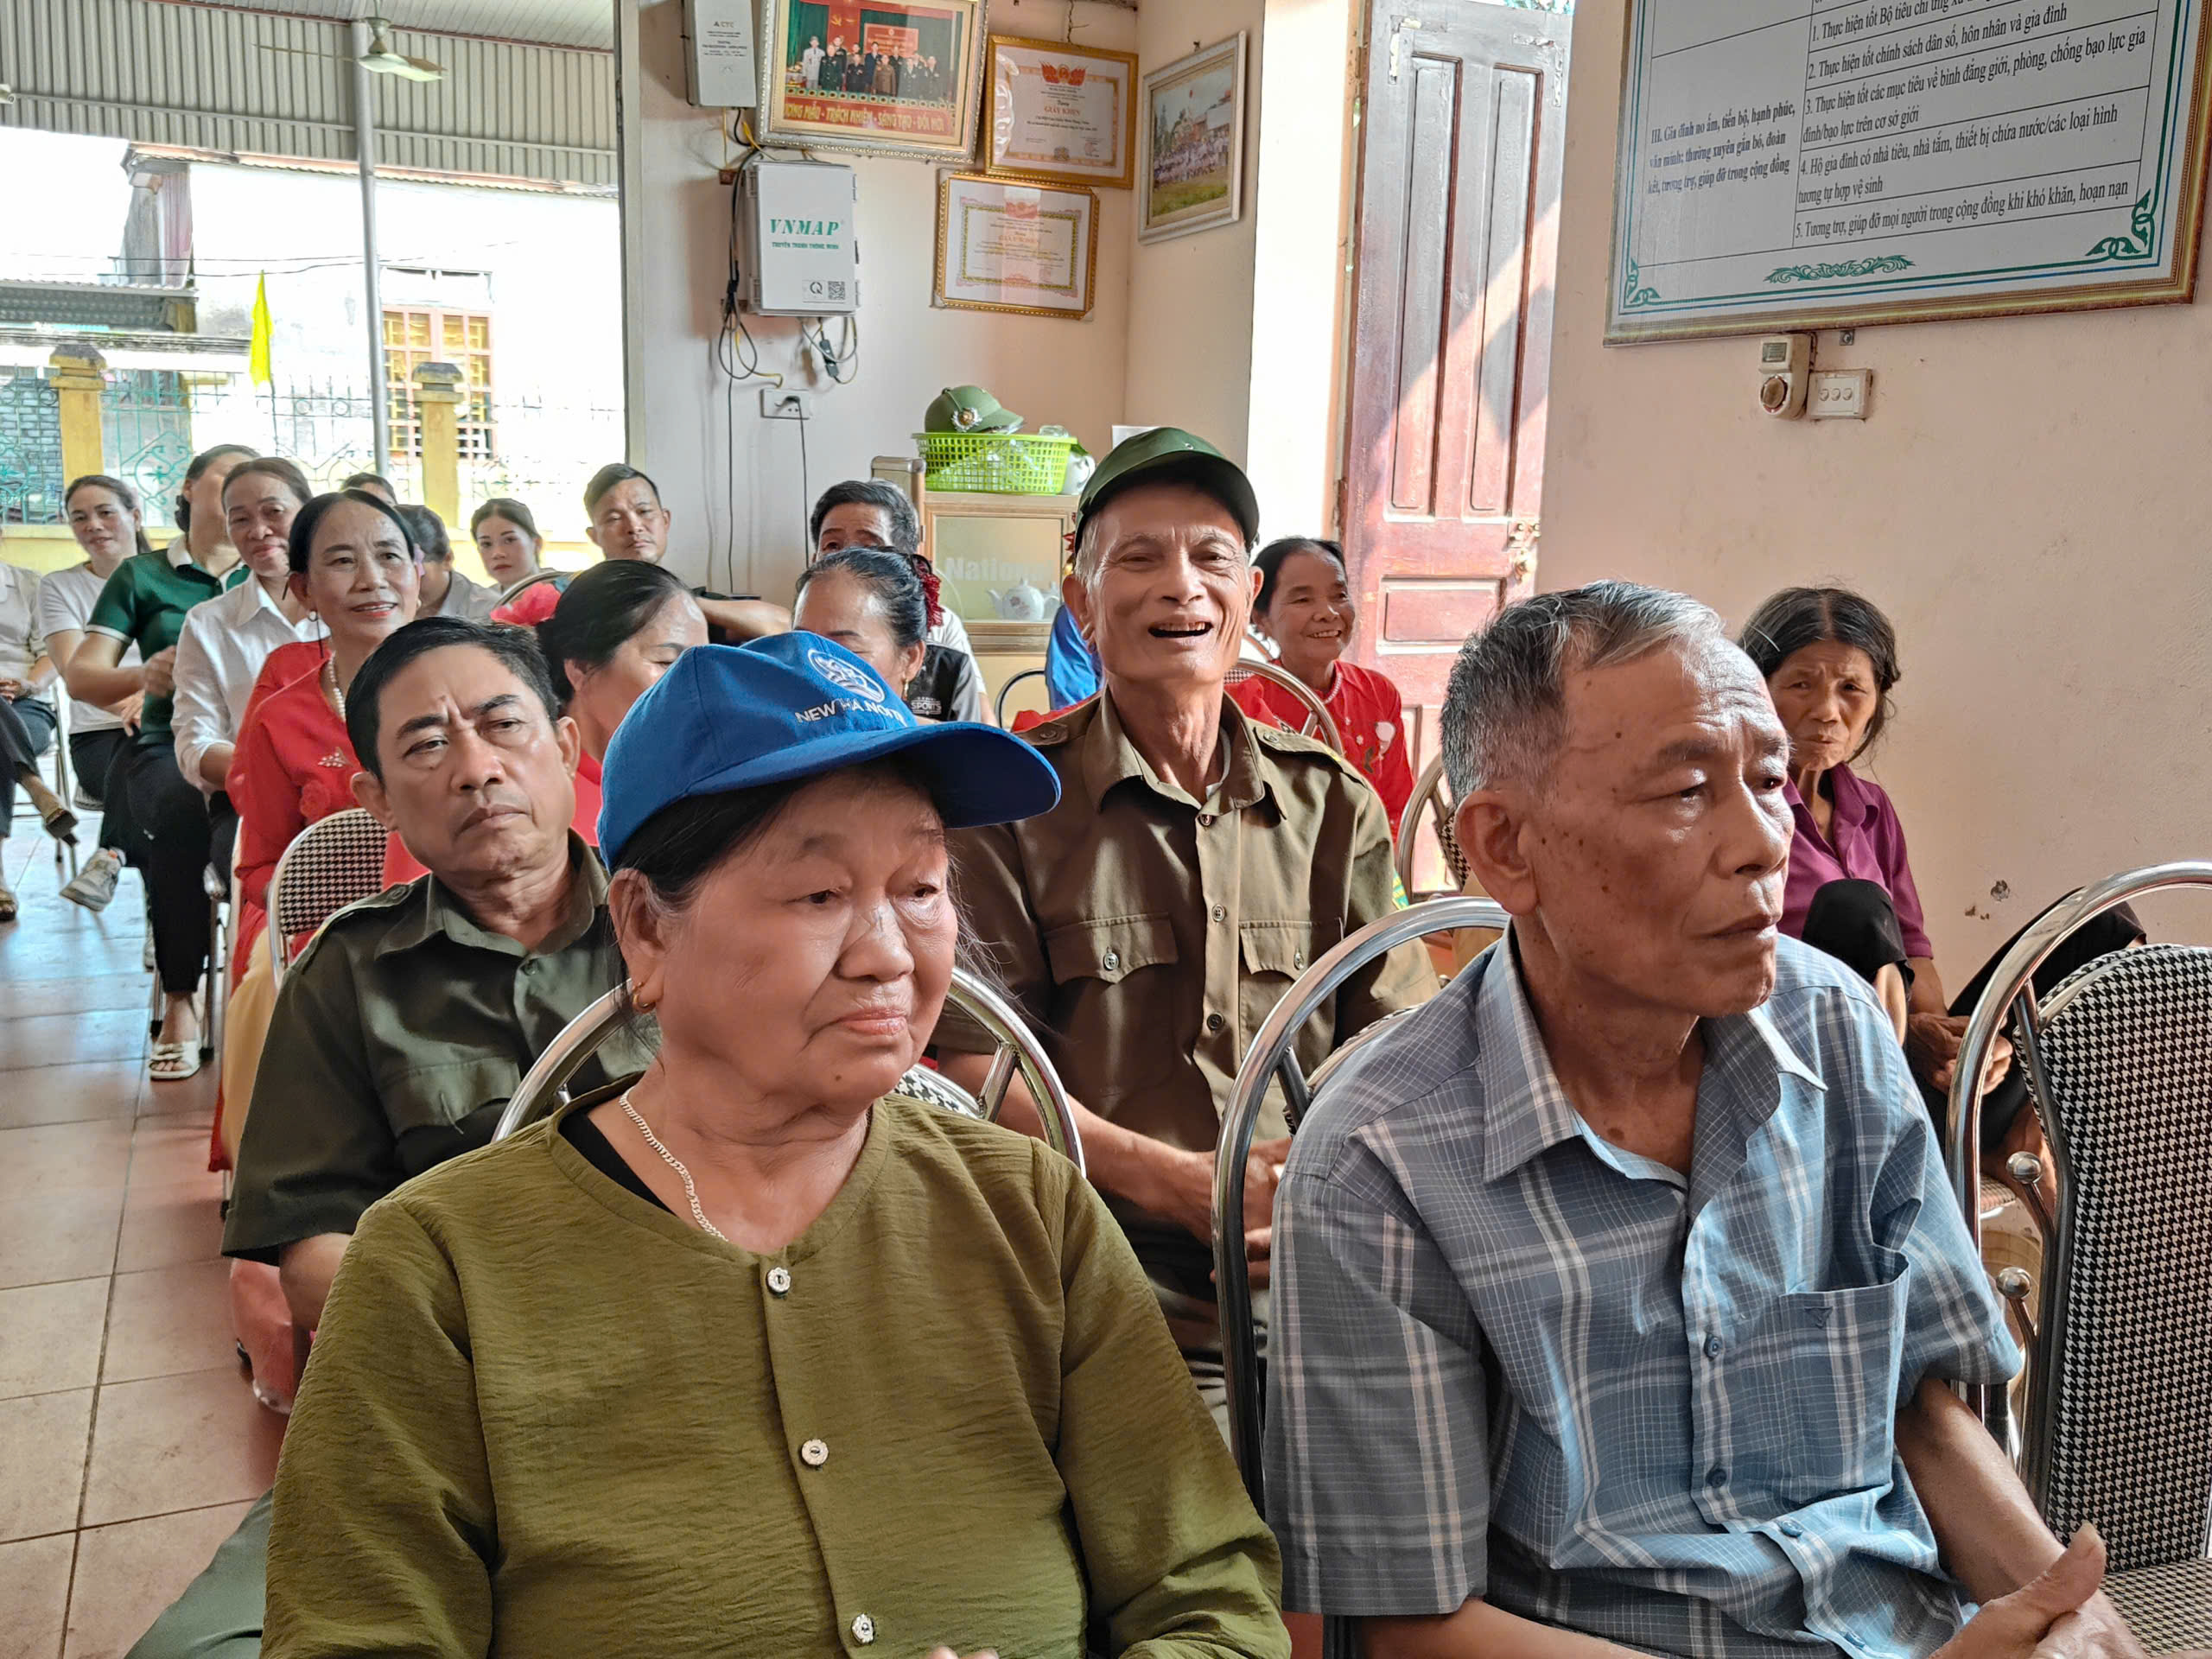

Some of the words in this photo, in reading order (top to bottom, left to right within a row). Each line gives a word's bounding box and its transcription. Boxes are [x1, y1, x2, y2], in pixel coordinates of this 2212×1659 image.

[1812, 25, 1819, 41] 1.
[1822, 22, 1843, 40] Thực
[1845, 15, 1864, 35] hiện
[1866, 5, 1878, 28] tốt
[1880, 7, 1892, 27] Bộ
[1895, 1, 1912, 20] tiêu
[1808, 64, 1815, 79] 2.
[1819, 59, 1840, 79] Thực
[1842, 54, 1859, 74] hiện
[1862, 45, 1874, 67] tốt
[1876, 43, 1901, 64] chính
[1903, 38, 1923, 58] sách
[1925, 34, 1942, 53] dân
[1944, 24, 1959, 49] số,
[1961, 25, 1980, 44] hôn
[1982, 18, 2006, 39] nhân
[2010, 13, 2022, 33] và
[2024, 9, 2040, 34] gia
[2043, 3, 2068, 25] đình
[1805, 99, 1813, 115] 3.
[1815, 94, 1836, 114] Thực
[1837, 90, 1855, 111] hiện
[1858, 82, 1869, 104] tốt
[1871, 83, 1885, 101] các
[1886, 83, 1905, 100] mục
[1908, 74, 1924, 94] tiêu
[1927, 66, 1938, 88] về
[1940, 66, 1961, 86] bình
[1987, 55, 2010, 81] giới,
[2012, 50, 2048, 77] phòng,
[2050, 36, 2082, 62] chống
[2086, 37, 2105, 59] bạo
[2107, 32, 2126, 54] lực
[2127, 26, 2145, 52] gia
[1695, 124, 1705, 135] no
[1722, 108, 1736, 129] tiến
[1738, 109, 1750, 129] bộ,
[1751, 105, 1771, 126] hạnh
[1772, 100, 1796, 123] phúc,
[1802, 120, 1839, 143] đình/bạo
[1840, 119, 1854, 139] lực
[1856, 115, 1873, 133] trên
[1875, 116, 1886, 130] cơ
[1900, 105, 1920, 129] giới
[1752, 133, 1764, 150] bó,
[1765, 130, 1787, 147] đoàn
[1801, 160, 1808, 175] 4.
[1810, 156, 1823, 176] Hộ
[1825, 155, 1838, 176] gia
[1839, 152, 1859, 170] đình
[1859, 149, 1872, 166] có
[1872, 145, 1889, 164] nhà
[1891, 143, 1910, 161] tiêu,
[1913, 137, 1930, 157] nhà
[1955, 124, 1978, 149] thiết
[1980, 126, 1990, 149] bị
[1992, 123, 2017, 143] chứa
[2018, 113, 2068, 139] nước/các
[2069, 107, 2091, 132] loại
[2093, 104, 2118, 126] hình
[1727, 167, 1748, 182] trong
[1750, 160, 1768, 180] cộng
[1770, 152, 1790, 175] đồng
[1823, 187, 1833, 203] tự
[1834, 182, 1851, 202] hợp
[1853, 179, 1864, 199] vệ
[1865, 175, 1884, 194] sinh
[770, 219, 840, 236] VNMAP
[1795, 222, 1803, 238] 5.
[1848, 214, 1867, 237] giúp
[1869, 212, 1881, 229] đỡ
[1882, 208, 1900, 230] mọi
[1900, 205, 1929, 229] người
[1929, 203, 1955, 224] trong
[1955, 200, 1980, 220] cộng
[1980, 190, 2006, 217] đồng
[2007, 191, 2024, 211] khi
[2025, 188, 2046, 208] khó
[2048, 186, 2076, 206] khăn,
[2079, 182, 2105, 203] hoạn
[2107, 181, 2128, 200] nạn
[795, 702, 836, 723] NEW
